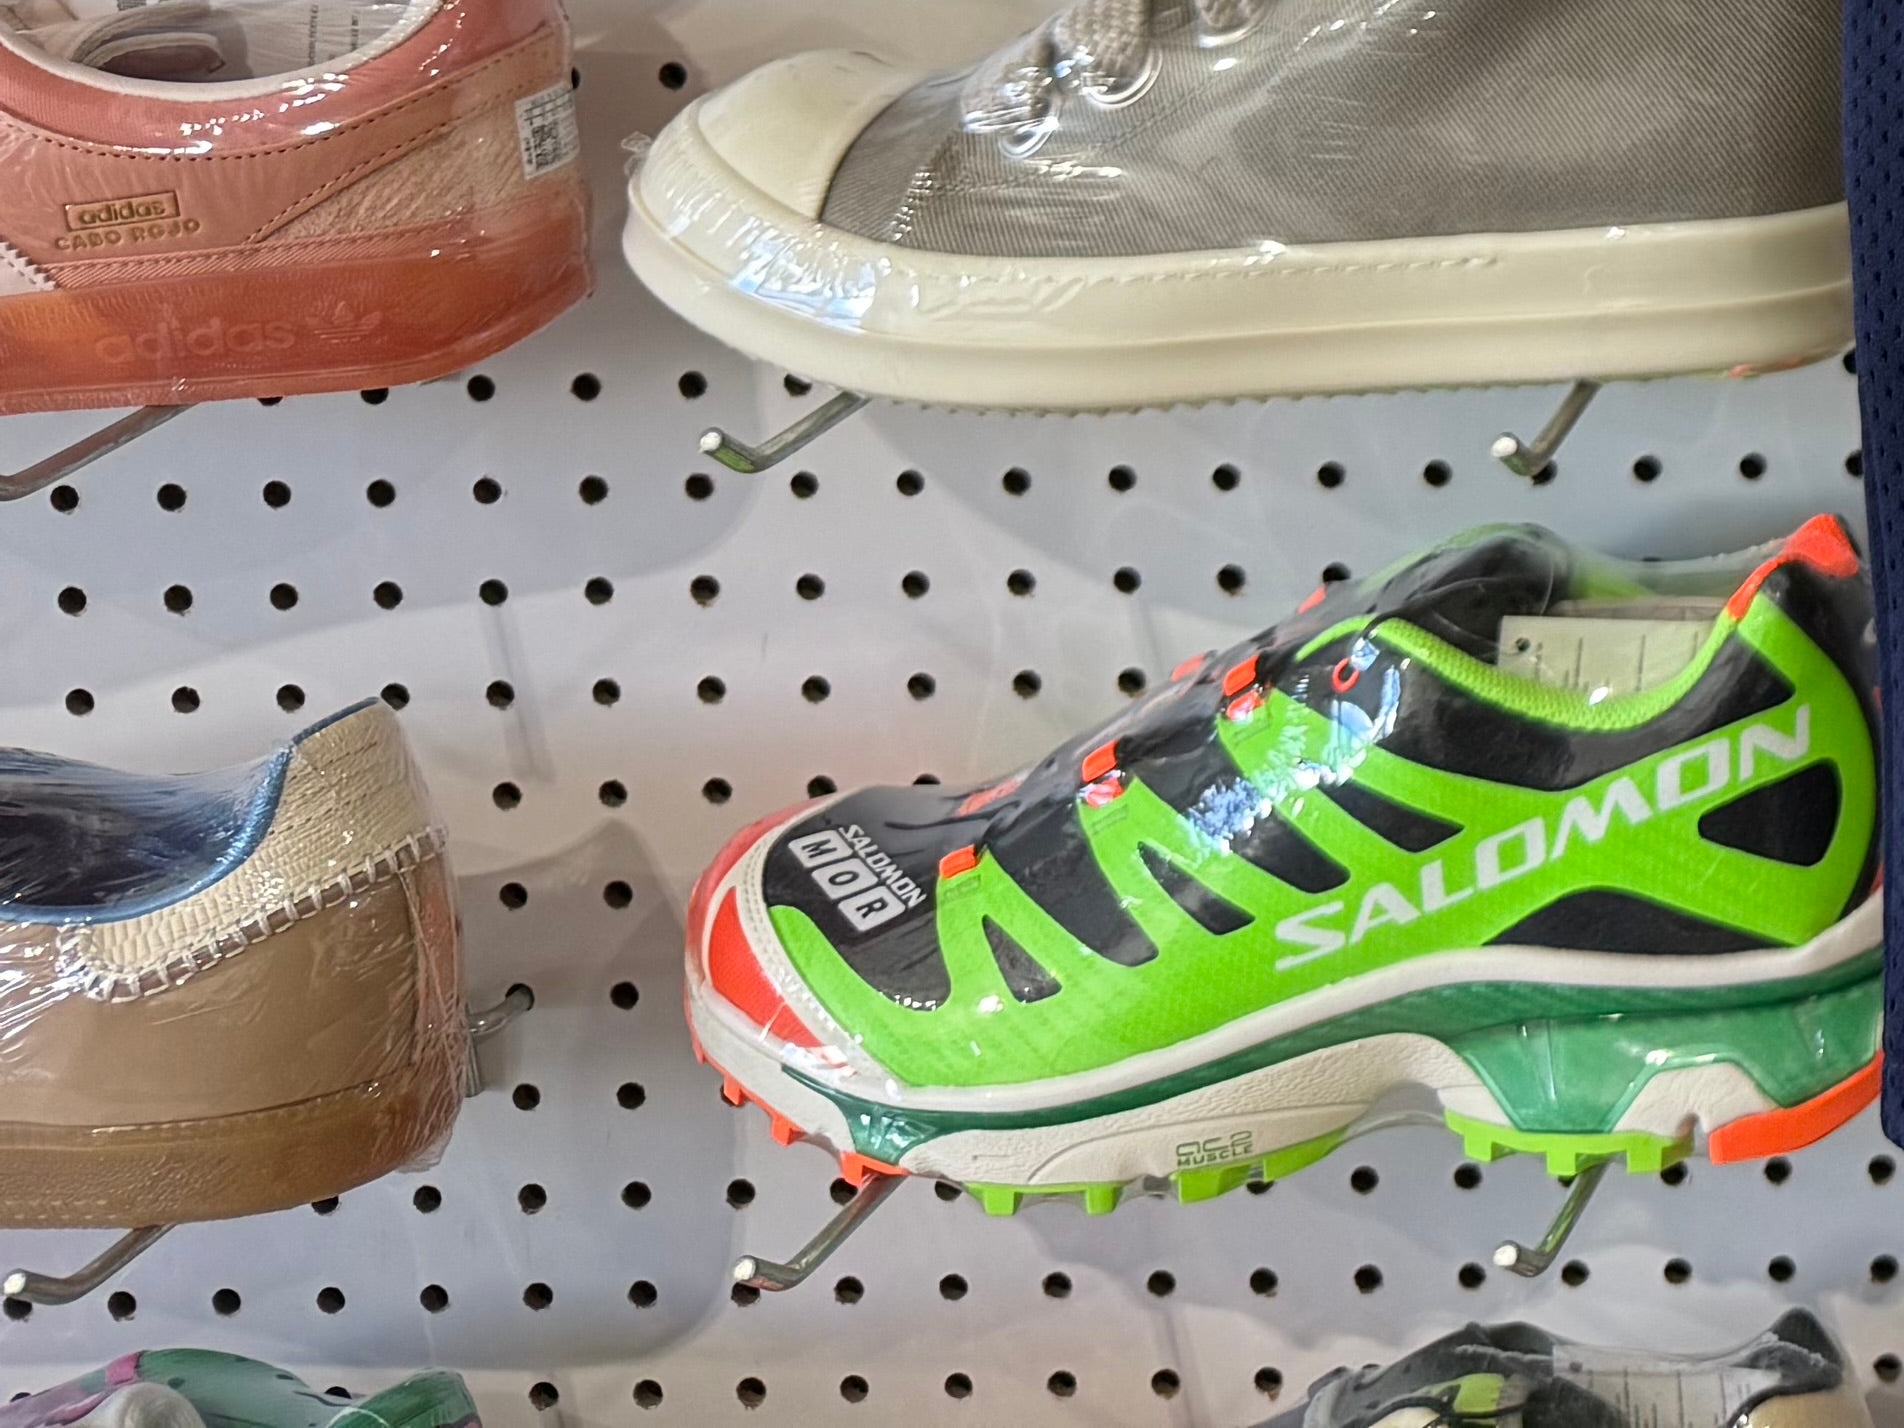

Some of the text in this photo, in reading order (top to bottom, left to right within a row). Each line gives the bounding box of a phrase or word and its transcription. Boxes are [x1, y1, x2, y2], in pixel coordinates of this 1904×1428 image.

[78, 198, 166, 226] adidas
[97, 316, 296, 365] adidas
[1274, 703, 1811, 973] SALOMON
[838, 824, 928, 910] SALOMON
[1177, 1143, 1253, 1167] MUSCLE
